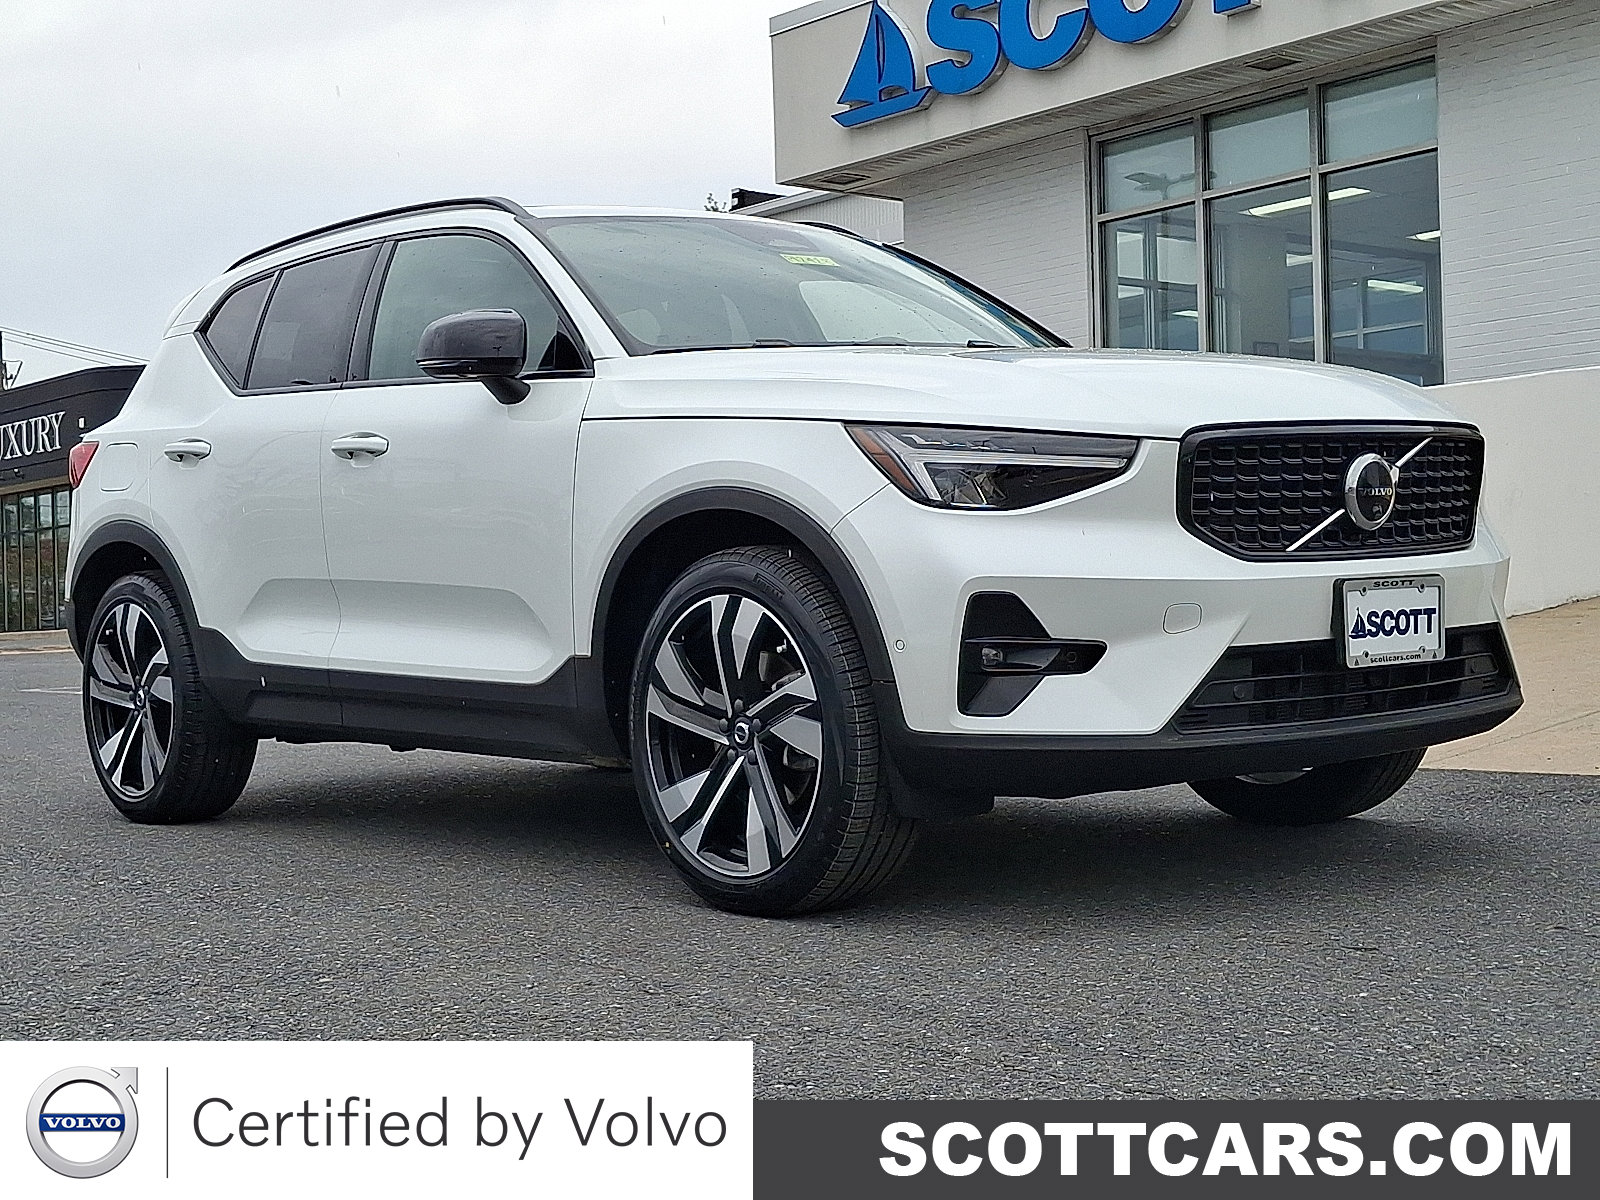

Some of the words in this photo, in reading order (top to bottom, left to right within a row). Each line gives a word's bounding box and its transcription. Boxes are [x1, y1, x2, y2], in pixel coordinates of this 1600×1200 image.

[1373, 579, 1415, 587] SCOTT
[1366, 607, 1437, 638] SCOTT
[1370, 653, 1421, 664] scottcars.com
